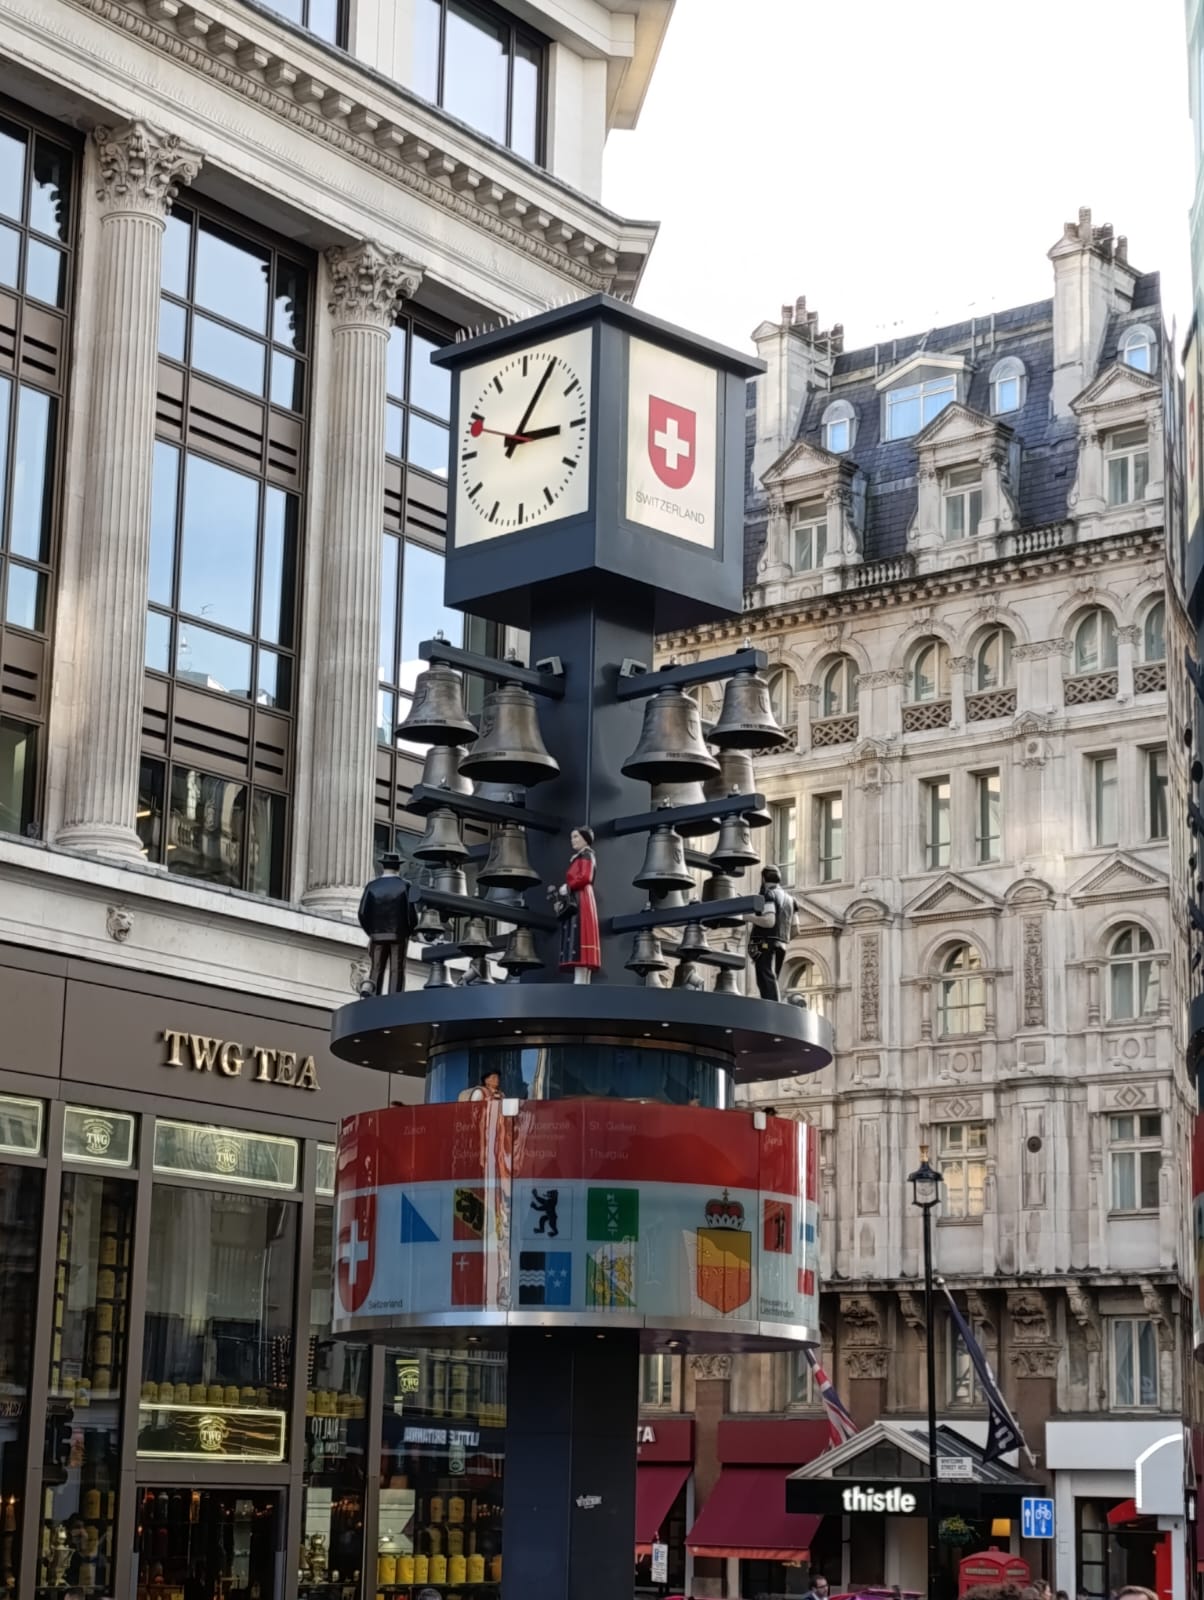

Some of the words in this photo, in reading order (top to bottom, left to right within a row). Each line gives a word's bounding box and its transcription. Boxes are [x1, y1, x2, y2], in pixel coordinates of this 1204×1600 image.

[635, 490, 705, 525] SWITZERLAND
[164, 1028, 245, 1077] TWG
[253, 1045, 321, 1090] TEA
[86, 1132, 108, 1146] TWG
[216, 1151, 236, 1164] TWG
[401, 1377, 420, 1387] TWG
[202, 1430, 221, 1441] TWG
[842, 1485, 917, 1513] thistle
